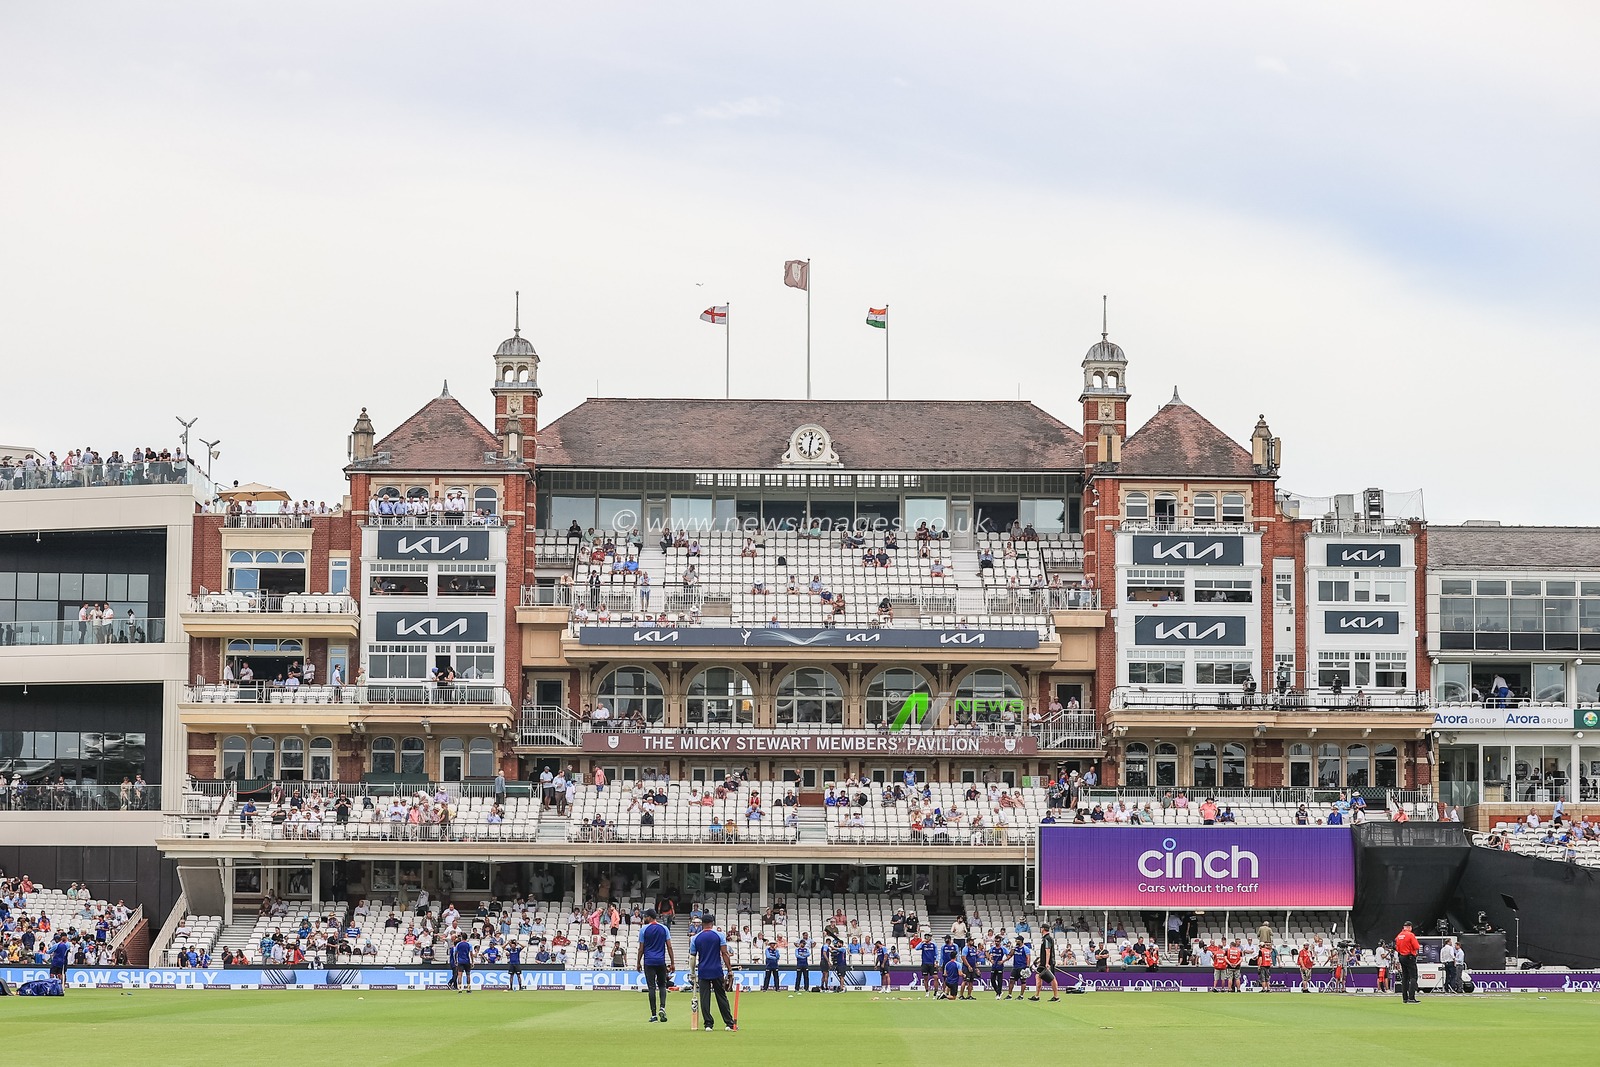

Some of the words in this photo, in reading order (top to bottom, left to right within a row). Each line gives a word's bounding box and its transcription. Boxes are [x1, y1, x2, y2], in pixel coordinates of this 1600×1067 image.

[1434, 714, 1468, 724] Arora
[1506, 714, 1540, 724] Arora
[642, 736, 674, 750] THE
[680, 736, 731, 750] MICKY
[736, 736, 811, 750] STEWART
[907, 737, 980, 751] PAVILION
[1138, 838, 1258, 878] cinch
[1138, 883, 1166, 892] Cars
[1169, 884, 1212, 892] without
[1216, 884, 1234, 892] the
[1236, 883, 1258, 892] faff
[118, 971, 218, 984] SHORTLY
[404, 972, 448, 985] THE
